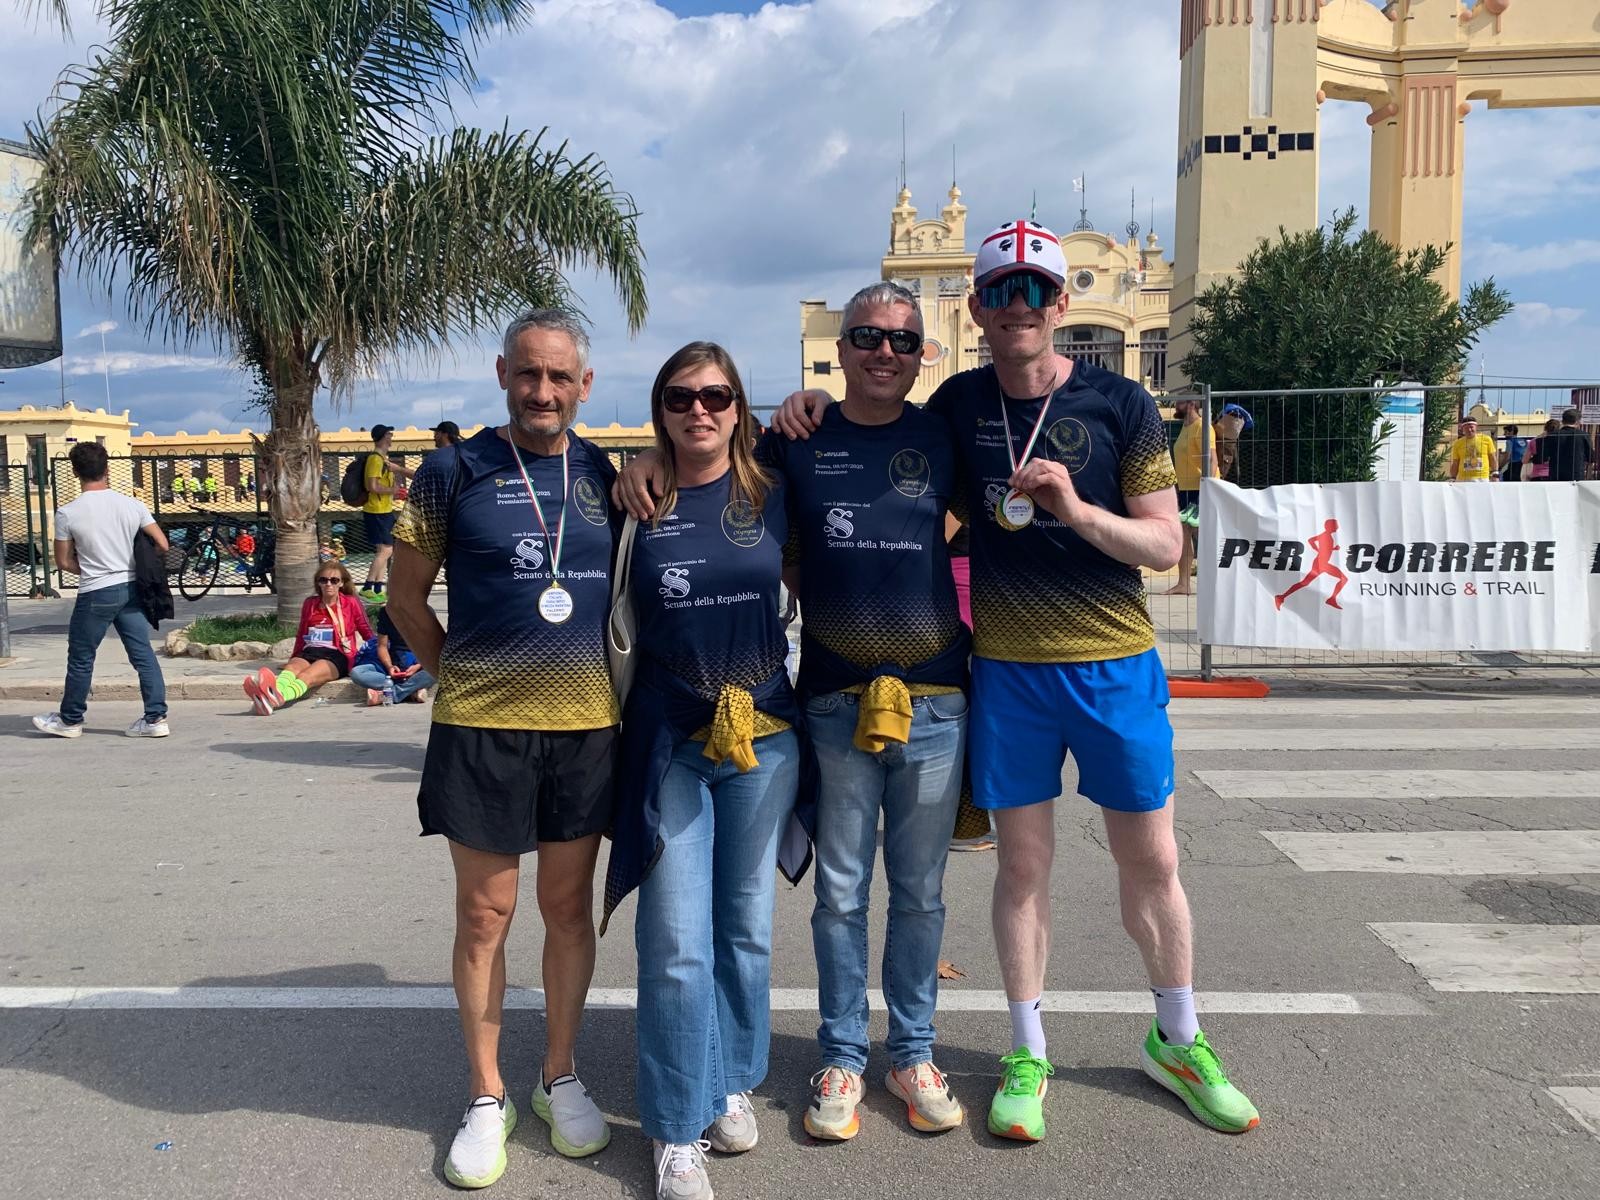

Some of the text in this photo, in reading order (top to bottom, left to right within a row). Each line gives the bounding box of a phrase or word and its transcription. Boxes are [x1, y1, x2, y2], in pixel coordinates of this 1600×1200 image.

[828, 540, 923, 551] Senato della Repubblica
[1217, 537, 1305, 572] PER
[1345, 540, 1556, 574] CORRERE
[513, 571, 543, 580] Senato
[567, 569, 607, 580] Repubblica
[1359, 581, 1545, 597] RUNNING & TRAIL
[664, 591, 760, 610] Senato della Repubblica
